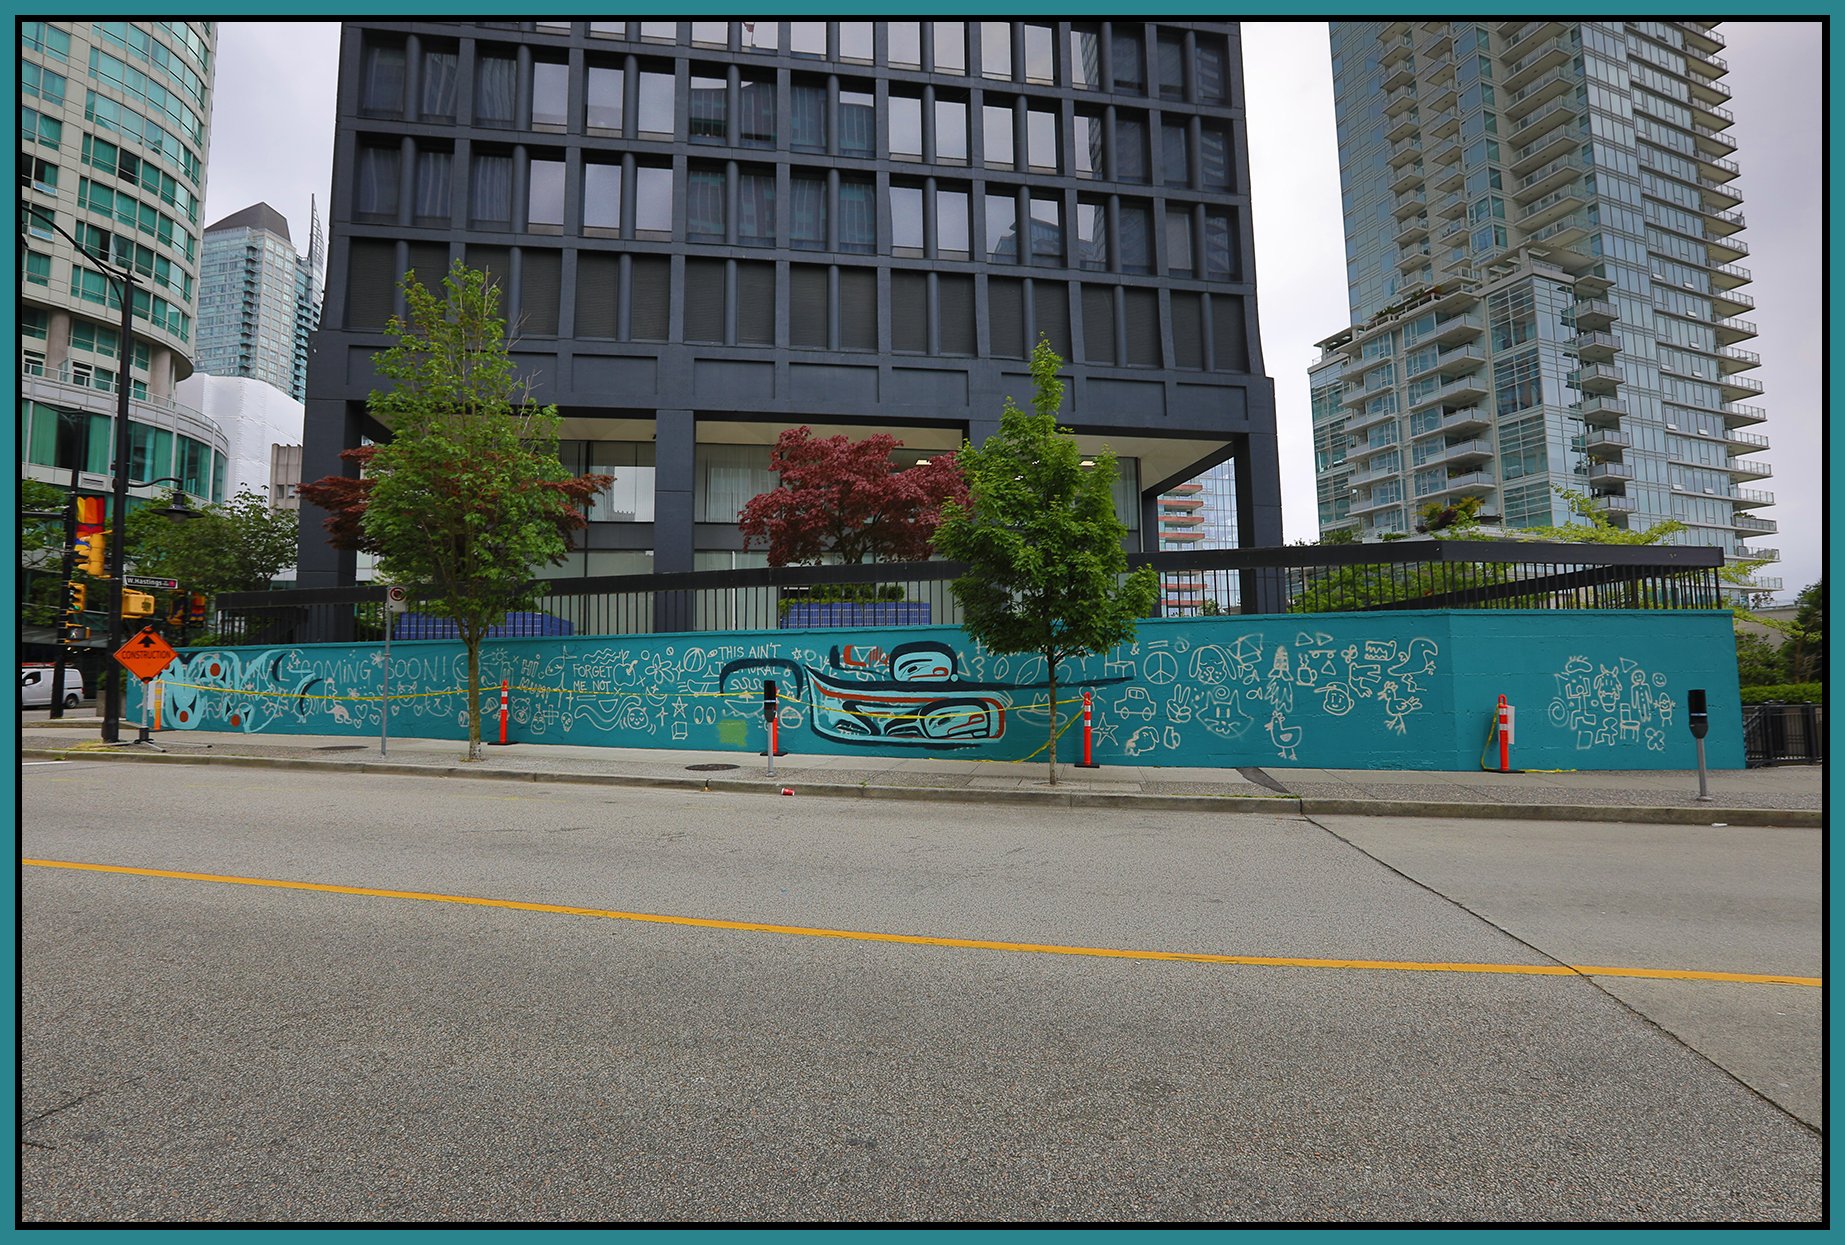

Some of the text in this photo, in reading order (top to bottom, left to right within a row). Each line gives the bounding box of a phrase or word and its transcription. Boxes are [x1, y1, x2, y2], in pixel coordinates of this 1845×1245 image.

[122, 650, 171, 659] CONSTRUCTION
[718, 642, 782, 660] THIS AIN'T
[387, 656, 446, 682] SOON!
[573, 664, 612, 679] FORGET
[573, 681, 611, 692] ME NOT
